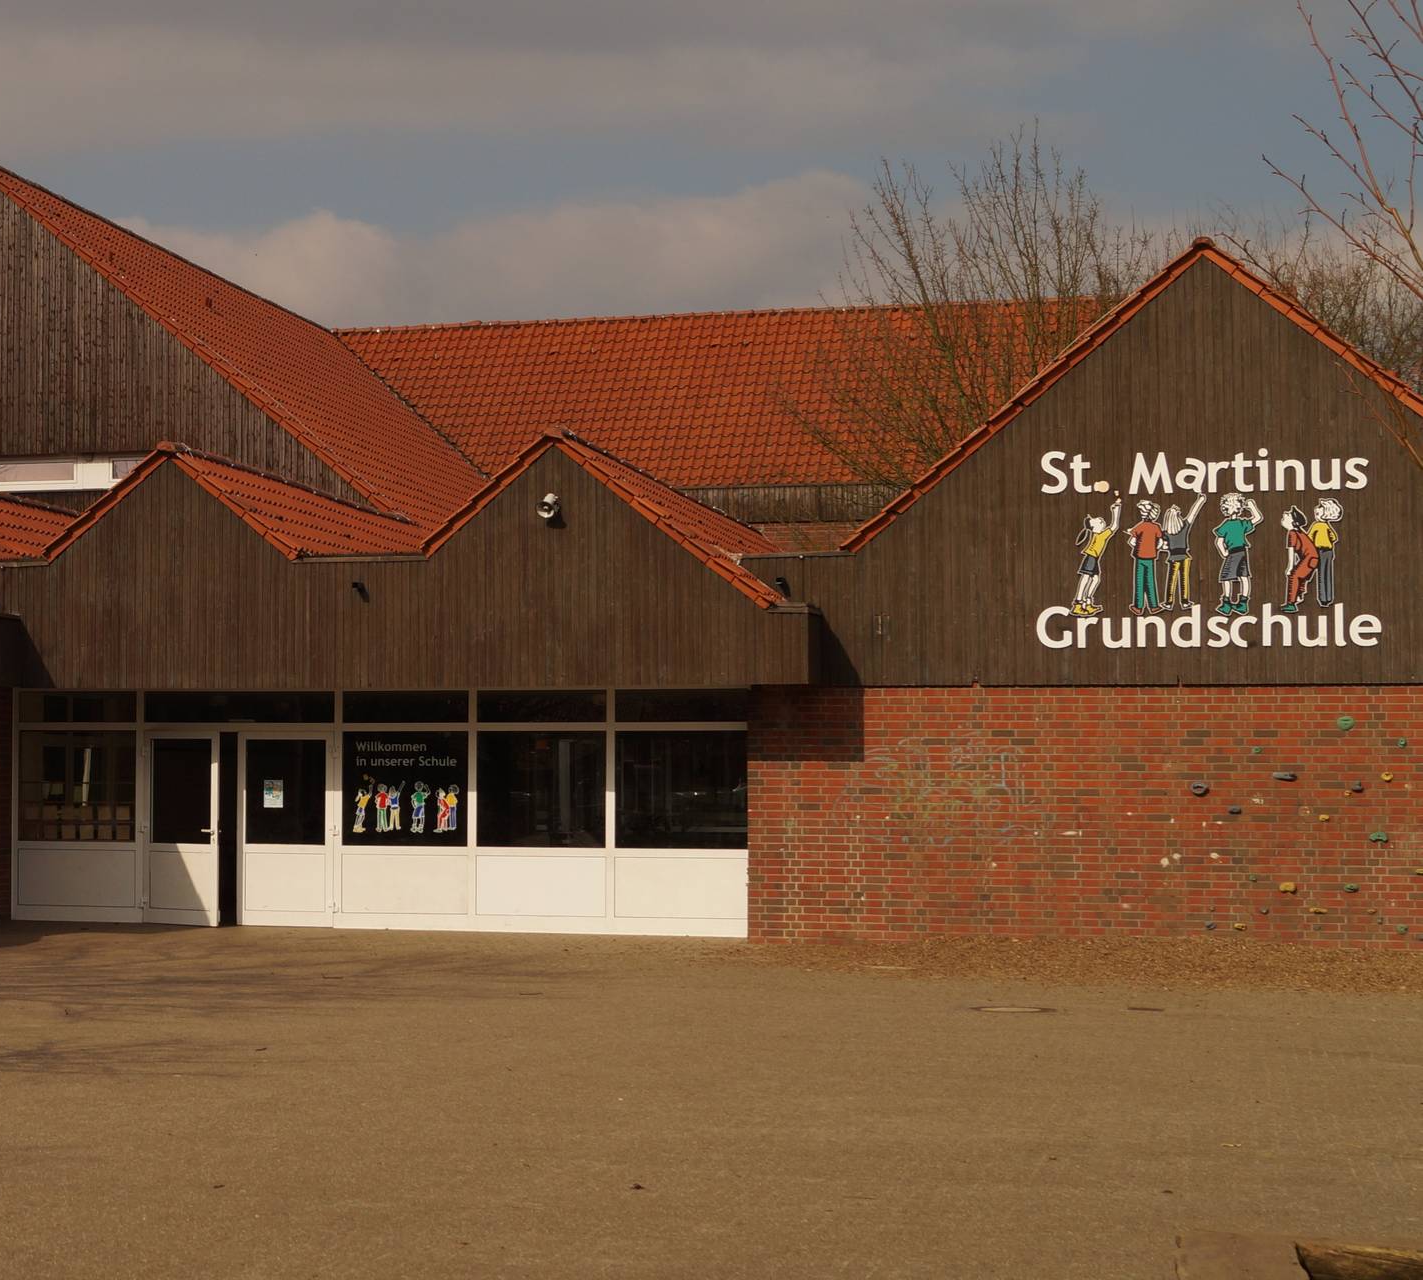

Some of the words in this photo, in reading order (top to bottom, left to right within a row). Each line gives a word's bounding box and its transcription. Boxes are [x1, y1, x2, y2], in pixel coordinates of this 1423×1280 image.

[1040, 451, 1110, 494] St.
[1128, 448, 1370, 495] Martinus
[1035, 603, 1383, 649] Grundschule
[356, 741, 427, 752] Willkommen
[356, 756, 367, 767] in
[370, 758, 415, 767] unserer
[418, 756, 458, 767] Schule
